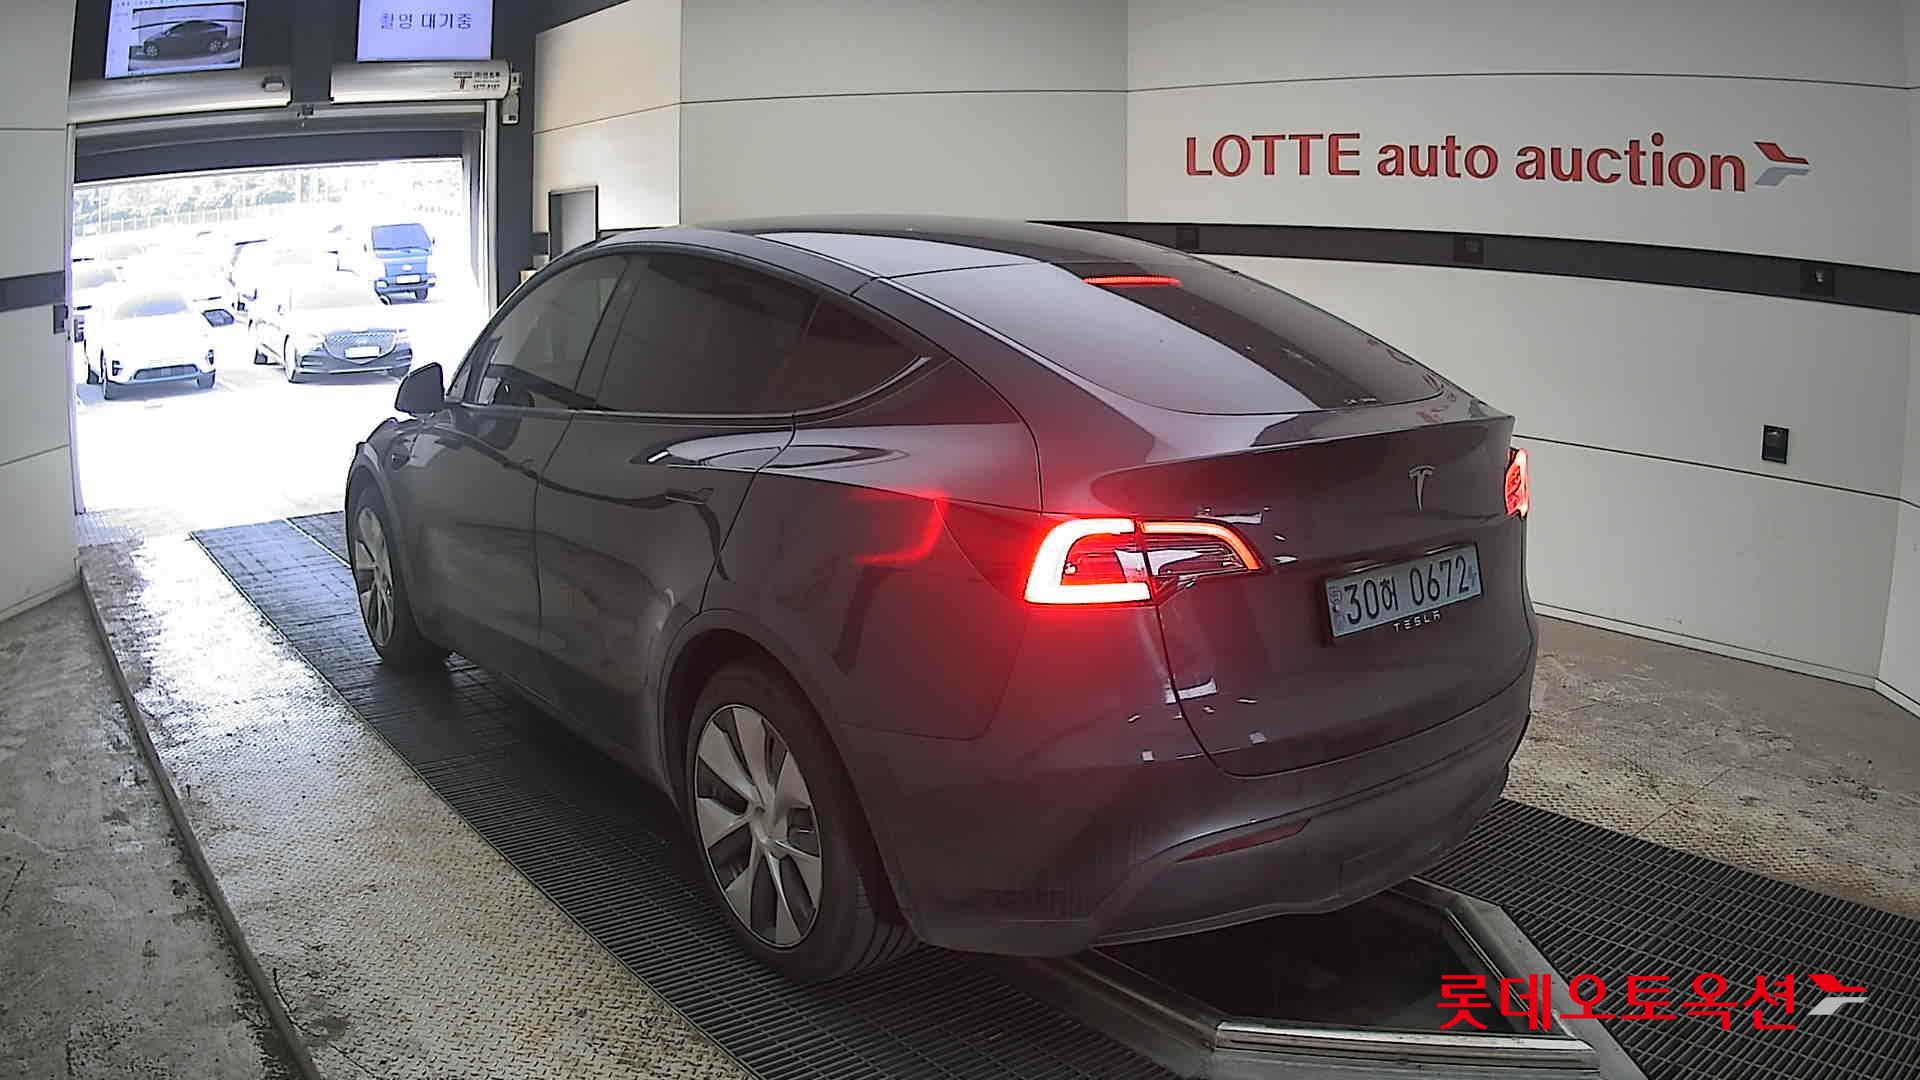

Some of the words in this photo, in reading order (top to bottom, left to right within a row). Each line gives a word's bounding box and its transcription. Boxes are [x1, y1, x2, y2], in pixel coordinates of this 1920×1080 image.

[421, 12, 472, 30] 대기중
[1185, 132, 1361, 177] LOTTE
[1376, 135, 1499, 179] auto
[1514, 132, 1746, 192] auction
[1343, 575, 1399, 625] 30허
[1409, 554, 1469, 606] 0672
[1392, 609, 1441, 633] TESLA
